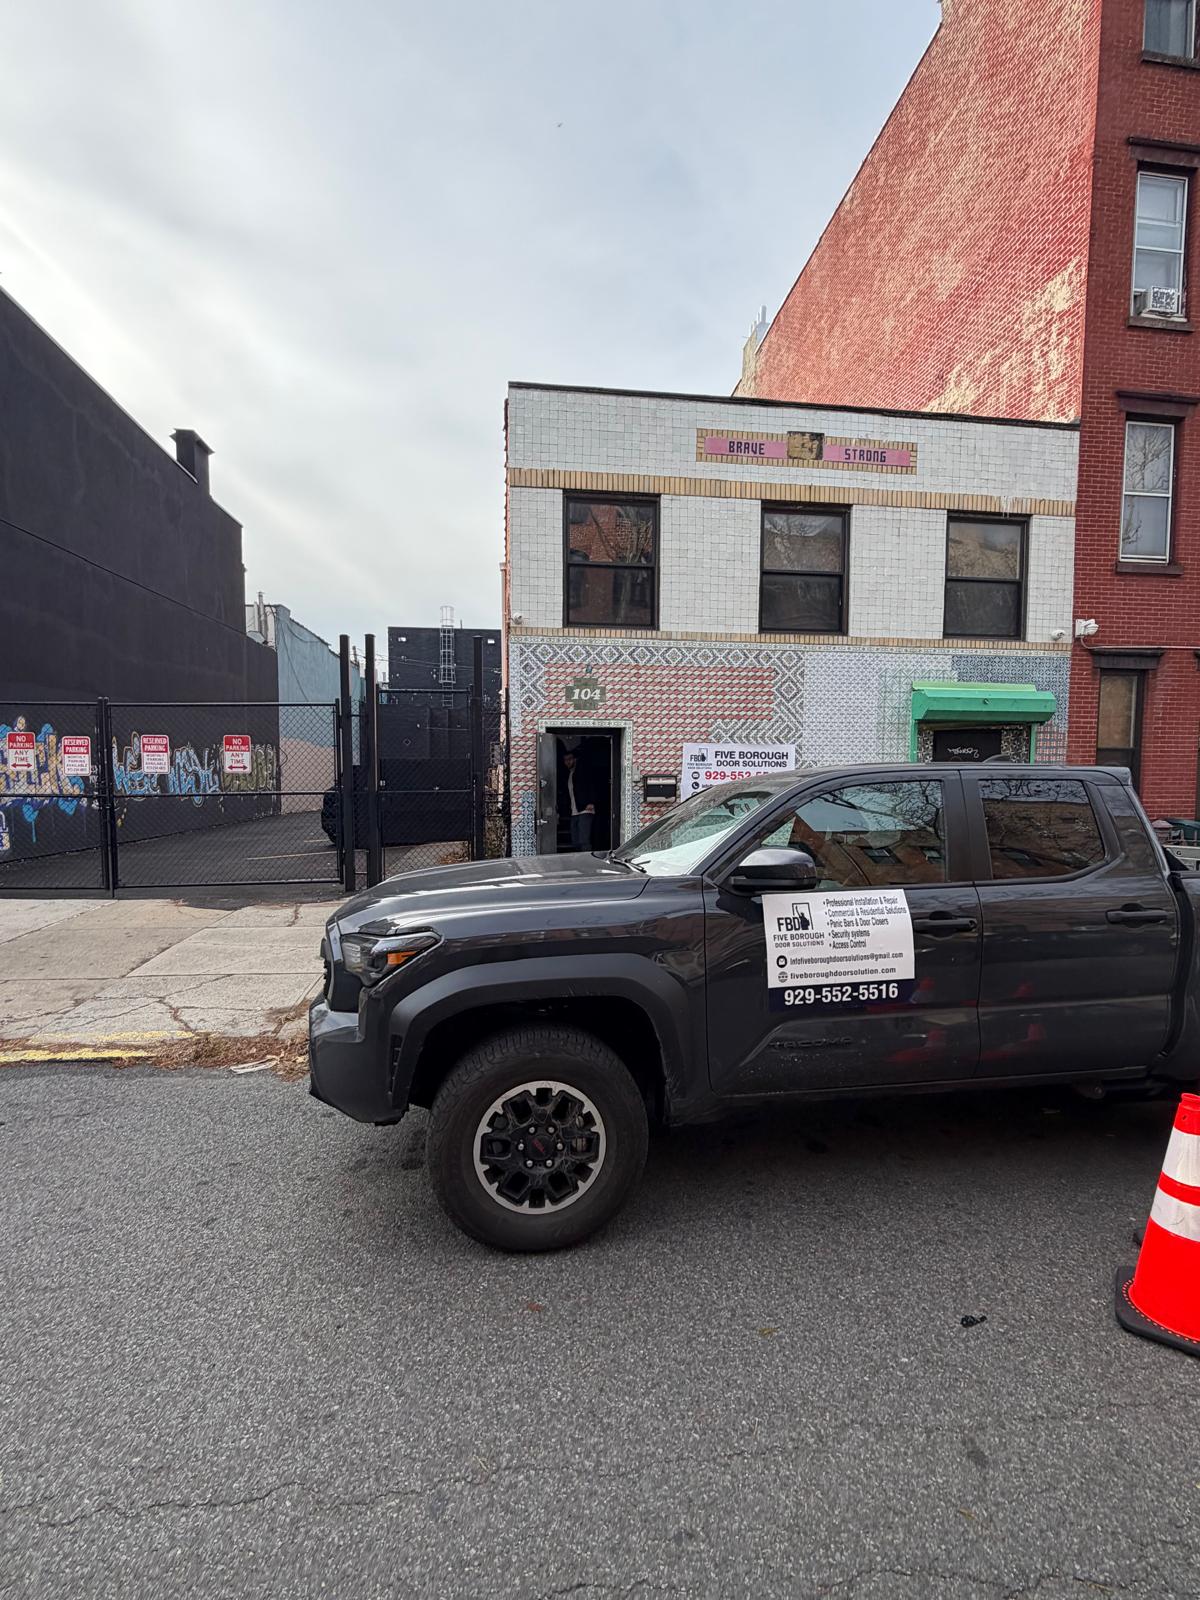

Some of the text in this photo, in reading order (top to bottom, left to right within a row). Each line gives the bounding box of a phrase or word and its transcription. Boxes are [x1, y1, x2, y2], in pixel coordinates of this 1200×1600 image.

[728, 440, 887, 463] BRAVE STRONG
[571, 688, 600, 700] 104
[714, 750, 789, 760] FIVE BOROUGH
[742, 760, 788, 768] SOLUTIONS
[826, 898, 854, 907] Professional
[883, 896, 898, 905] Repair
[828, 906, 907, 917] Commercial & Residential Solutions
[777, 917, 800, 932] FBD
[830, 917, 889, 928] Panic Bars & Door Closers
[773, 932, 825, 941] FIVE BOROUGH
[831, 929, 870, 940] Security systems
[832, 939, 866, 949] Access Control
[790, 967, 897, 980] fiveboroughdoorsolution.com
[784, 982, 899, 1006] 929-552-5516
